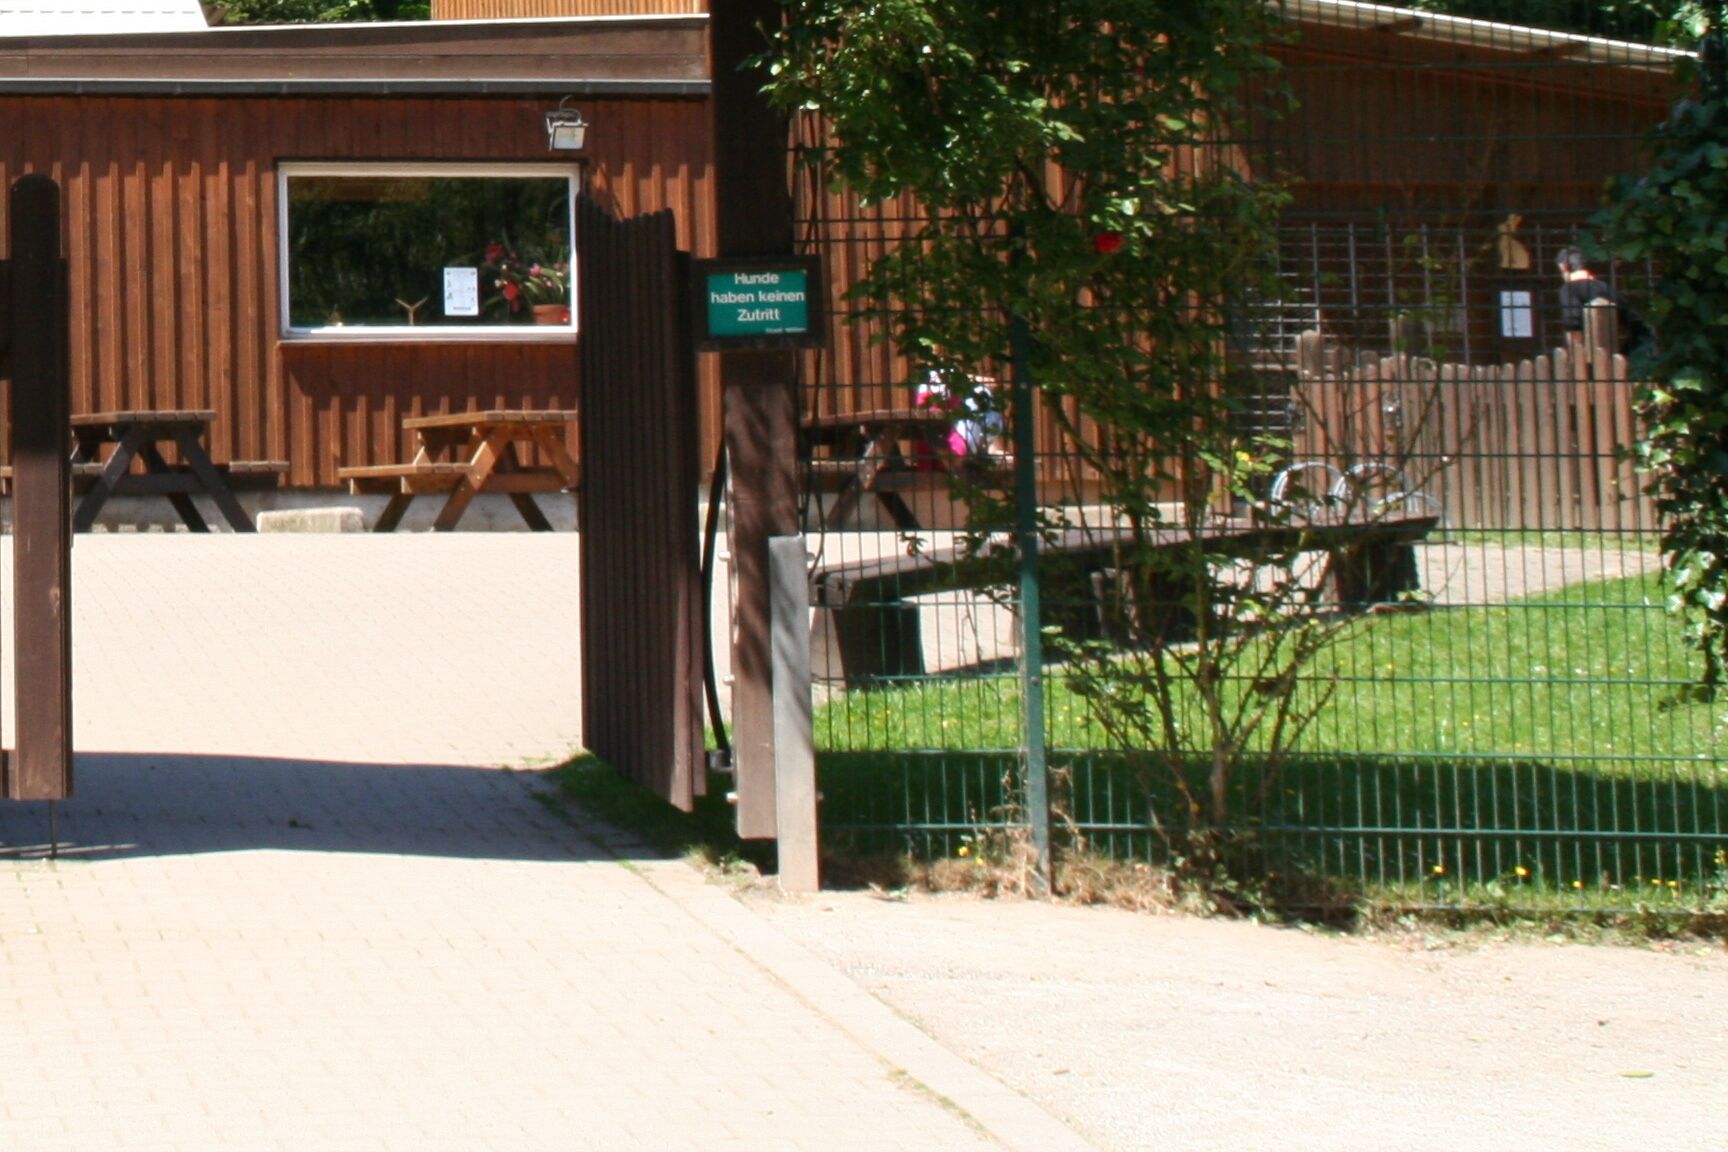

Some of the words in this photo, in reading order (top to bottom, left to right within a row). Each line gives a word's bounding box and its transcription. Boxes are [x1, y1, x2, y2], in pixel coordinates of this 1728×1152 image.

[734, 272, 780, 285] Hunde
[710, 291, 755, 304] haben
[758, 290, 805, 302] keinen
[737, 309, 780, 322] Zutritt
